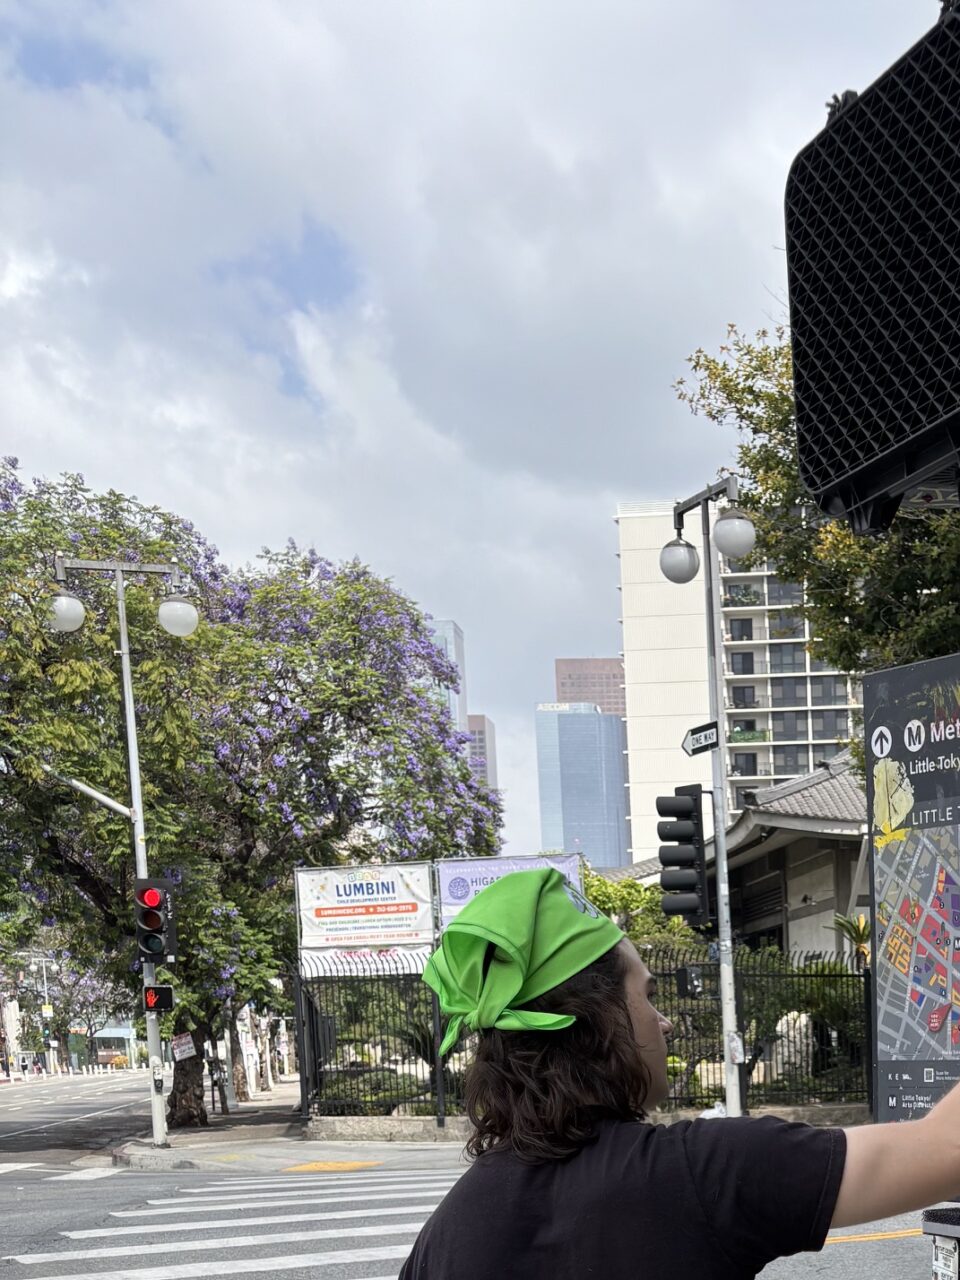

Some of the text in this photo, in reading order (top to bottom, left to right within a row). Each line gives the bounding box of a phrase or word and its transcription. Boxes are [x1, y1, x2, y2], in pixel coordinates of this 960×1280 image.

[692, 731, 715, 748] ONE WAY
[910, 757, 935, 775] Little
[912, 807, 953, 826] LITTLE
[336, 881, 395, 898] LUMBINI
